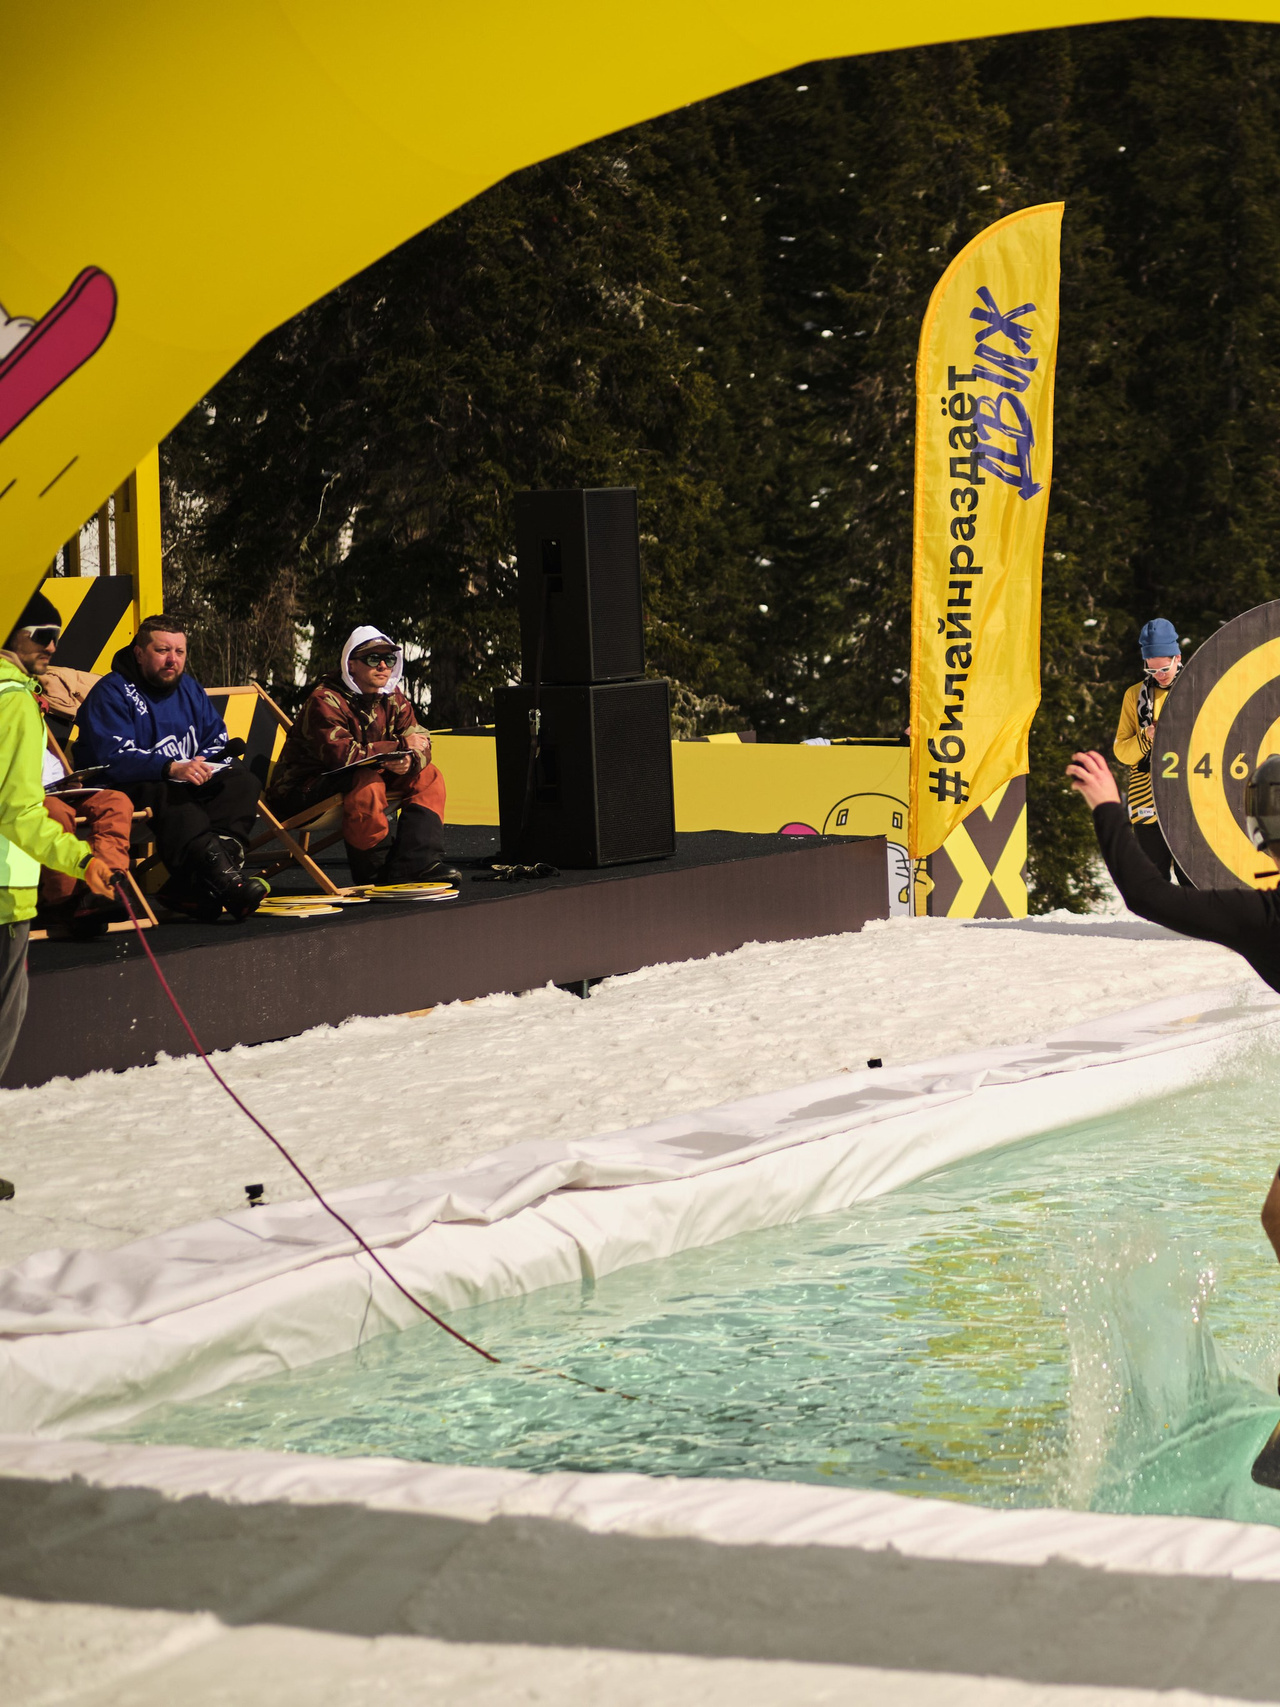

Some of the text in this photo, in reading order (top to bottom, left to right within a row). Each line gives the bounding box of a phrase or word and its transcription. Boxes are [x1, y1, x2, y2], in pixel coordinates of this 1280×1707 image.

[927, 365, 986, 805] #билайнраздаёт
[1161, 752, 1180, 779] 2
[1193, 753, 1213, 779] 4
[1230, 753, 1249, 780] 6
